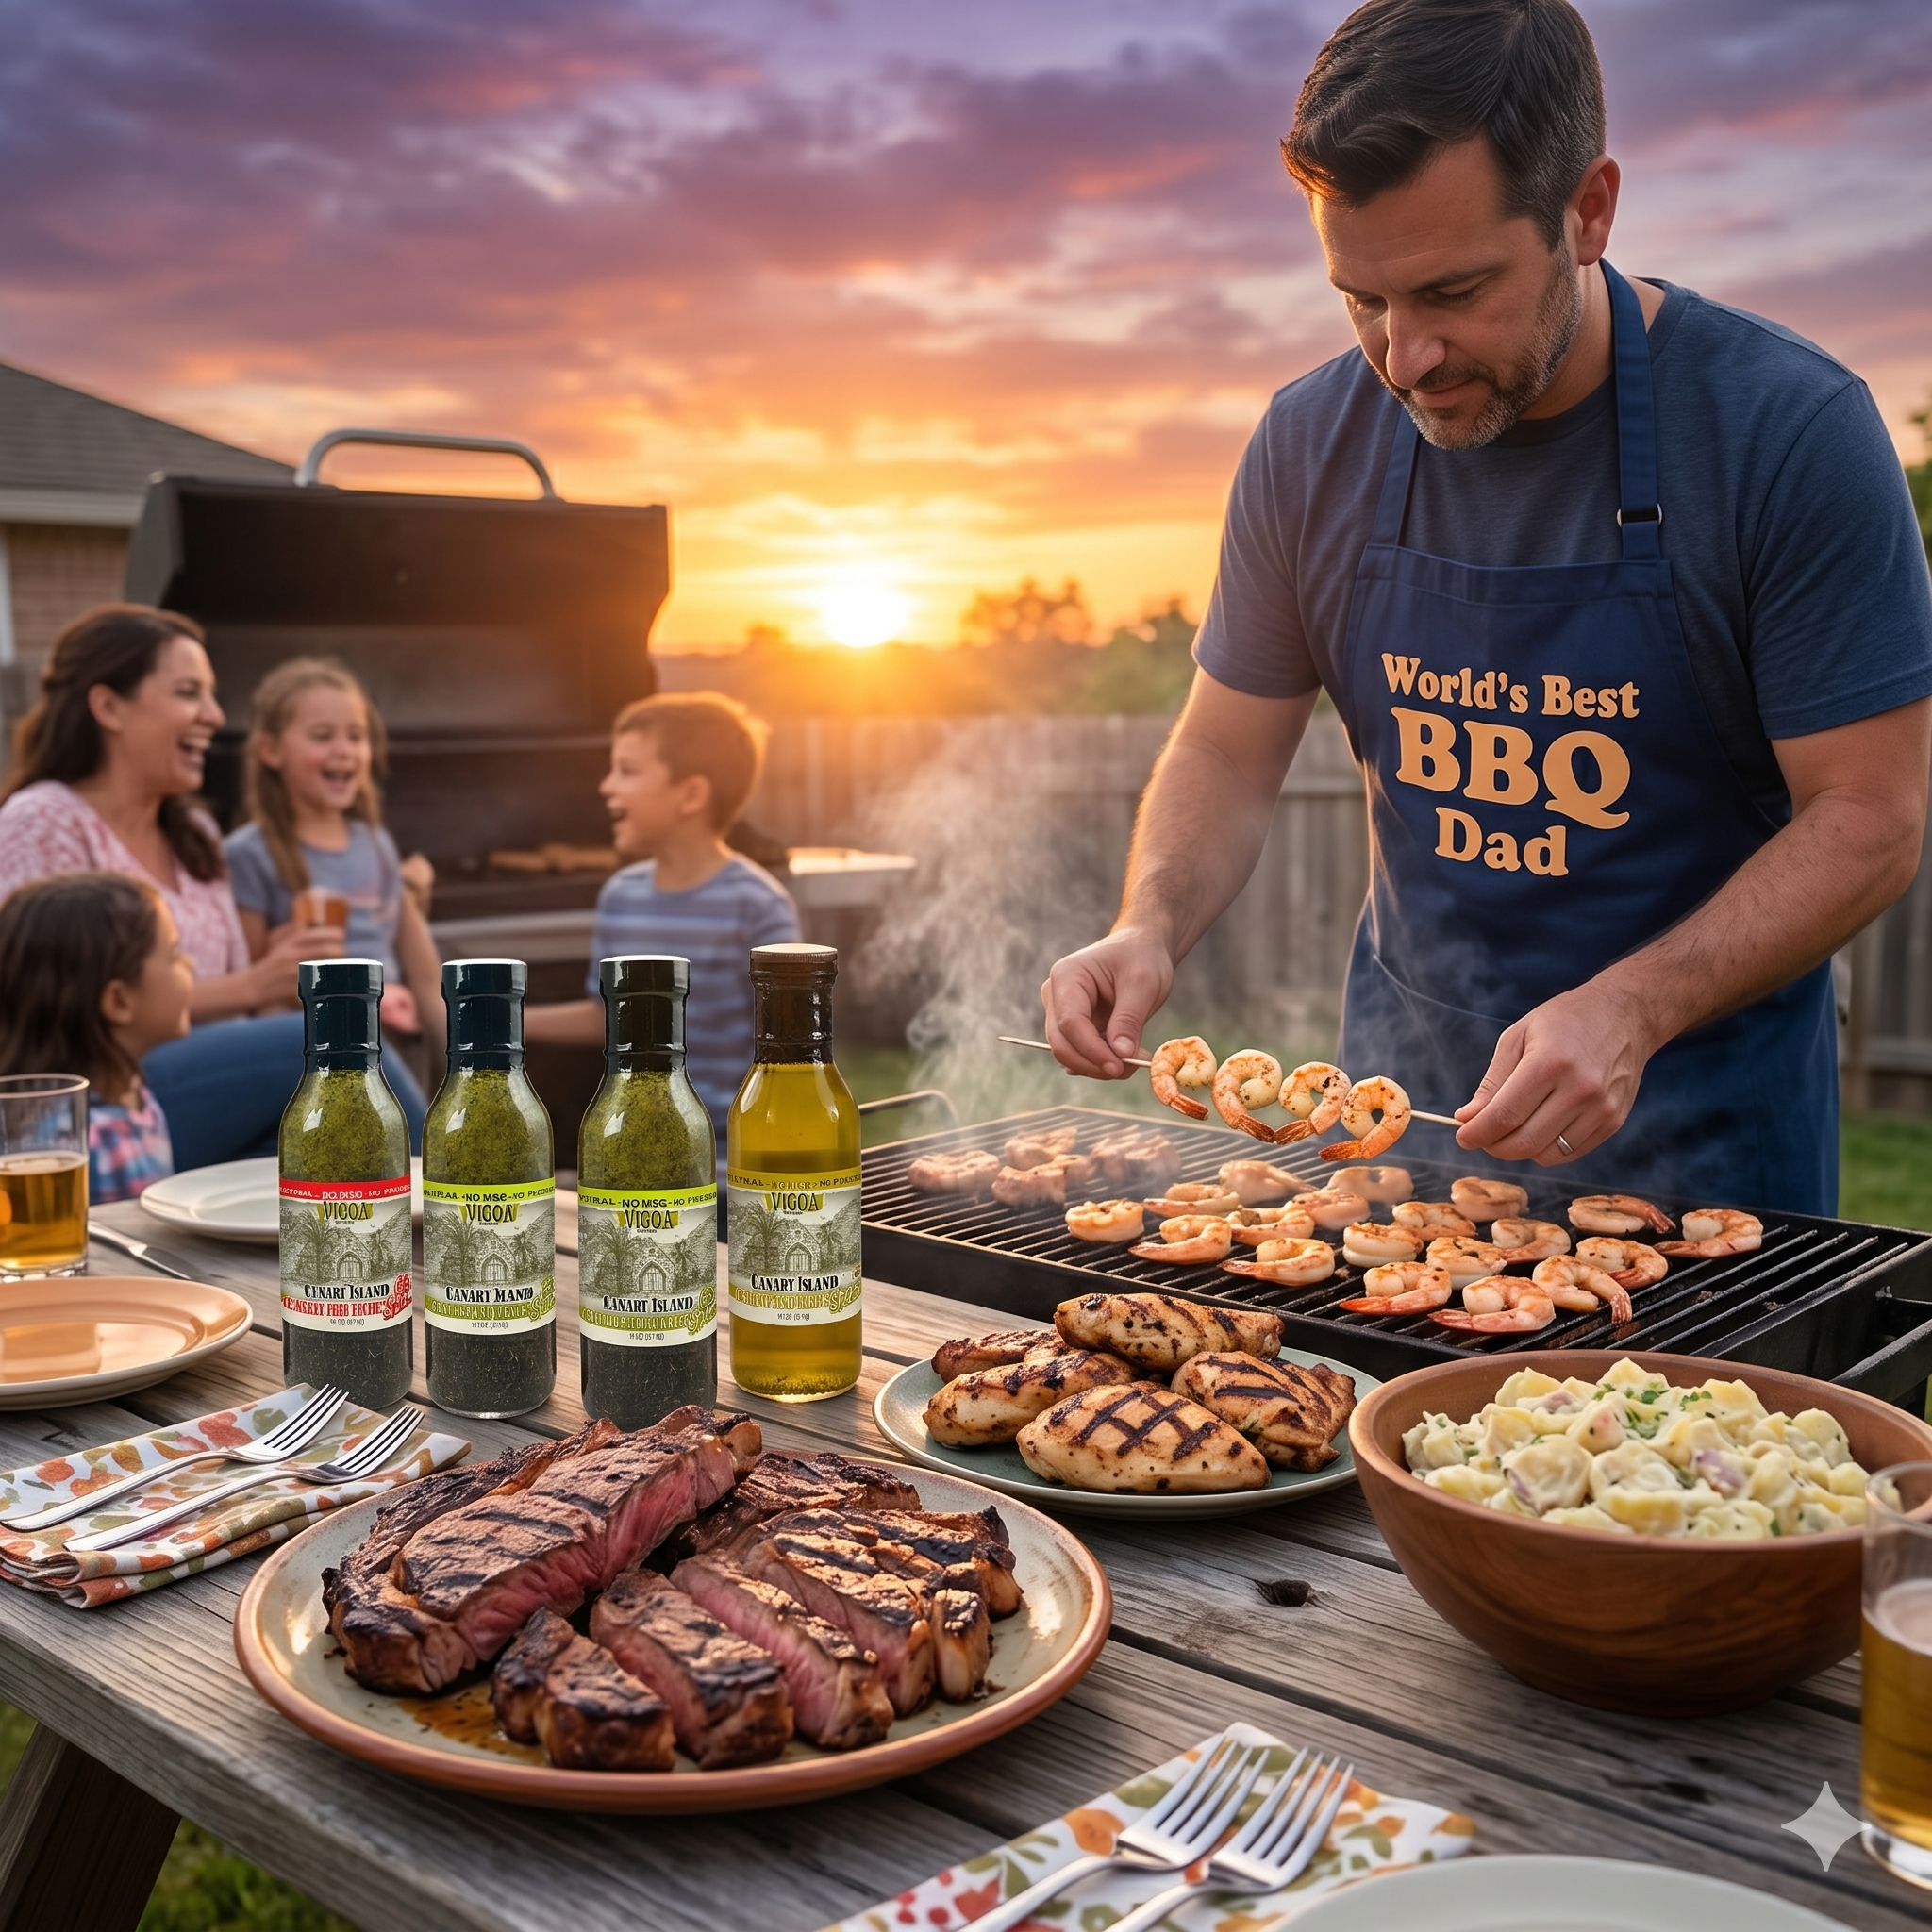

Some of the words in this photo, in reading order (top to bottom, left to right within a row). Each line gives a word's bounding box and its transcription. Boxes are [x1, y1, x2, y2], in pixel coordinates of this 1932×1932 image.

[1381, 652, 1529, 714] World's
[1541, 675, 1640, 719] Best
[1391, 706, 1631, 830] BBQ
[1434, 806, 1570, 877] Dad
[622, 1198, 640, 1208] NO
[771, 1191, 819, 1212] VIGOA
[624, 1208, 674, 1230] VIGOA
[751, 1274, 795, 1291] CANARY
[797, 1274, 839, 1291] ISLAND
[651, 1295, 694, 1313] ISLAND
